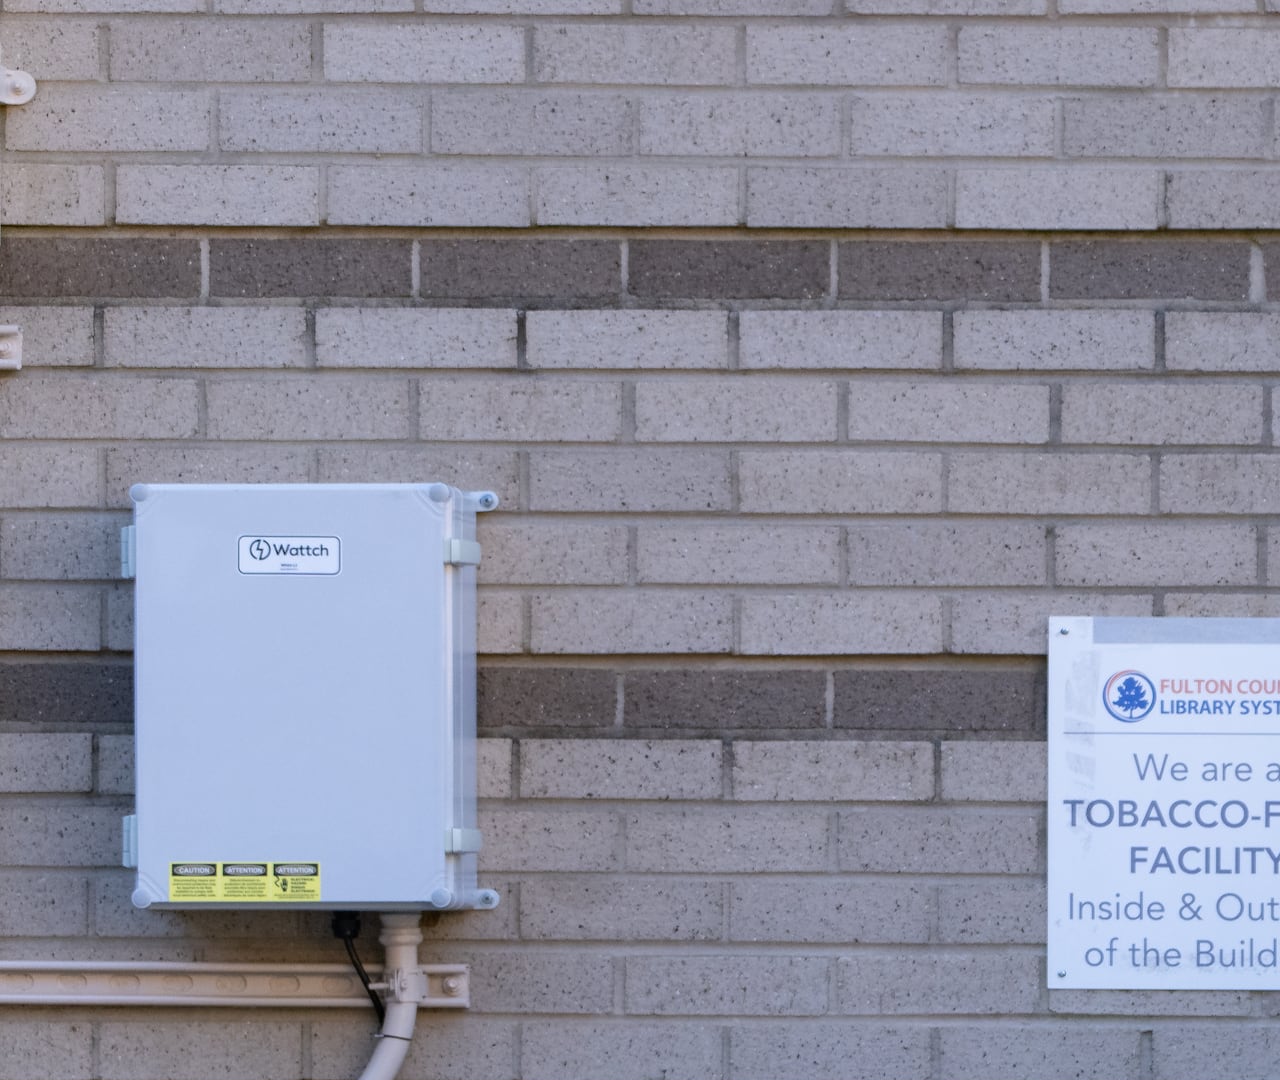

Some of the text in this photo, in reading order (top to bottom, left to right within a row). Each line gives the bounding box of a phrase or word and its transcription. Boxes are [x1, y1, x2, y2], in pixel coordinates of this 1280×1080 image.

[273, 543, 329, 556] Wattch
[1160, 679, 1233, 695] FULTON
[1160, 700, 1235, 715] LIBRARY
[1132, 753, 1189, 782] We
[1201, 762, 1253, 782] are
[1069, 891, 1165, 921] Inside
[1179, 893, 1203, 921] &
[1084, 937, 1119, 967] of
[1131, 938, 1182, 967] the
